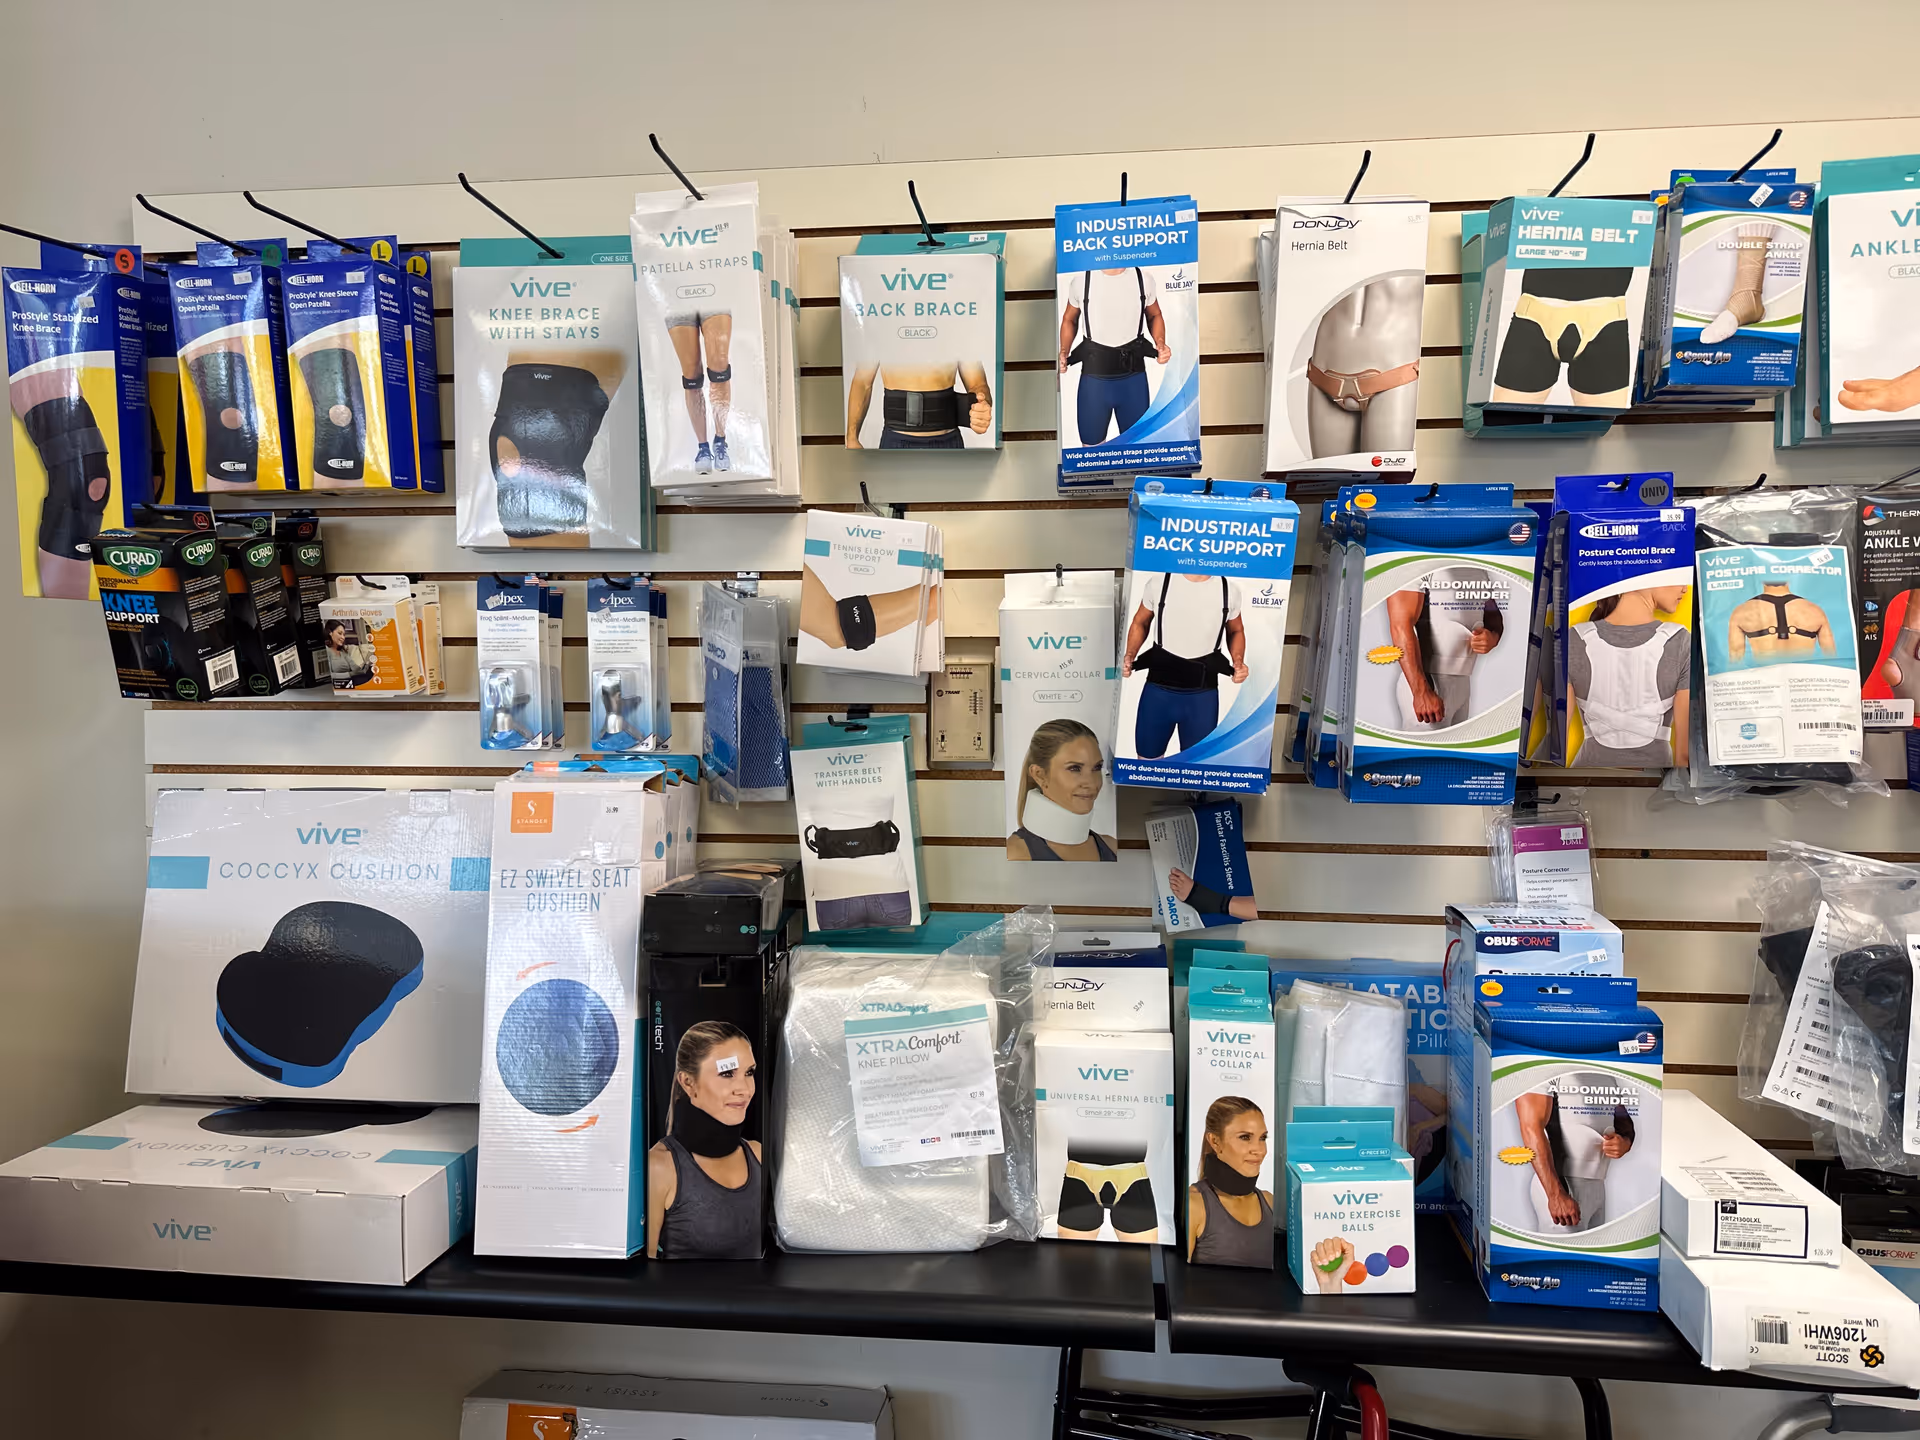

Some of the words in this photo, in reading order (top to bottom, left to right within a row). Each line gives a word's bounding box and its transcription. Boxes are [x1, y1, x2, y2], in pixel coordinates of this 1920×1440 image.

[1521, 206, 1560, 221] vive
[1076, 214, 1174, 234] INDUSTRIAL
[1293, 220, 1360, 229] DONJOY
[660, 226, 718, 248] vive
[1518, 225, 1584, 241] HERNIA
[1591, 228, 1638, 243] BELT
[1063, 237, 1107, 252] BACK
[1112, 230, 1188, 248] SUPPORT
[1292, 241, 1325, 250] Hernia
[1328, 240, 1348, 250] Belt
[1718, 241, 1763, 249] DOUBLE
[1766, 242, 1803, 250] STRAP
[378, 244, 386, 258] L
[1113, 252, 1157, 260] Suspenders
[120, 254, 129, 269] S
[641, 262, 693, 275] PATELLA
[700, 256, 748, 270] STRAPS
[880, 268, 947, 291] vive
[1183, 280, 1193, 288] JAY
[510, 277, 571, 297] vive
[684, 288, 707, 296] BLACK
[178, 295, 204, 303] ProStyle
[289, 292, 316, 300] ProStyle
[308, 300, 331, 308] Patella
[855, 303, 906, 316] BACK
[914, 302, 977, 316] BRACE
[489, 308, 532, 320] KNEE
[541, 308, 600, 320] BRACE
[13, 324, 34, 332] Knee
[36, 324, 61, 334] Brace
[490, 327, 535, 339] WITH
[543, 326, 600, 339] STAYS
[905, 329, 931, 337] BLACK
[1642, 486, 1666, 498] UNIV
[846, 525, 882, 539] vive
[1161, 517, 1271, 538] INDUSTRIAL
[1662, 523, 1686, 531] BACK
[1144, 536, 1195, 552] BACK
[1199, 539, 1285, 557] SUPPORT
[1864, 537, 1909, 549] ANKLE
[186, 543, 213, 560] CURAD
[833, 543, 862, 553] TENNIS
[865, 547, 894, 557] ELBOW
[1579, 548, 1614, 557] Posture
[1615, 547, 1649, 555] Control
[1651, 546, 1675, 554] Brace
[110, 550, 155, 566] CURAD
[843, 552, 881, 563] SUPPORT
[1178, 558, 1196, 566] with
[1198, 559, 1248, 569] Suspenders
[1705, 556, 1741, 567] vive
[1706, 566, 1766, 579] POSTURE
[1770, 565, 1842, 576] CORRECTOR
[1420, 580, 1510, 590] ABDOMINAL
[1252, 597, 1269, 605] BLUE
[1270, 598, 1284, 606] JAY
[1456, 591, 1509, 600] BINDER
[102, 592, 158, 614] KNEE
[106, 611, 159, 624] SUPPORT
[1027, 632, 1082, 650] vive
[1015, 671, 1061, 679] CERVICAL
[1064, 670, 1101, 678] COLLAR
[827, 753, 864, 765] vive
[814, 769, 859, 779] TRANSFER
[862, 767, 882, 775] BELT
[1138, 765, 1180, 774] duo-tension
[1204, 770, 1231, 778] provide
[816, 779, 839, 788] WITH
[842, 776, 882, 786] HANDLES
[1129, 774, 1165, 782] abdominal
[1221, 780, 1251, 788] support.
[1214, 812, 1224, 838] Plantar
[296, 822, 362, 845] vive
[1220, 838, 1230, 866] Fasciitis
[220, 862, 319, 880] COCCYX
[331, 863, 440, 880] CUSHION
[500, 870, 517, 888] EZ
[526, 869, 584, 888] SWIVEL
[593, 868, 630, 888] SEAT
[1224, 867, 1234, 890] Sleeve
[527, 893, 600, 912] CUSHION
[1166, 896, 1179, 926] DARCO
[1484, 936, 1552, 946] OBUSFORME
[1077, 1001, 1095, 1010] Belt
[1207, 1029, 1251, 1044] vive
[1212, 1049, 1264, 1059] CERVICAL
[1623, 1045, 1638, 1054] 36.99
[858, 1058, 887, 1069] KNEE
[890, 1053, 930, 1067] PILLOW
[1210, 1060, 1252, 1069] COLLAR
[1078, 1064, 1129, 1081] vive
[1548, 1085, 1639, 1095] ABDOMINAL
[1050, 1092, 1101, 1102] UNIVERSAL
[1105, 1095, 1139, 1103] HERNIA
[1144, 1096, 1164, 1104] BELT
[1584, 1096, 1639, 1106] BINDER
[1333, 1190, 1378, 1205] vive
[1314, 1211, 1345, 1220] HAND
[1350, 1209, 1401, 1219] EXERCISE
[152, 1218, 212, 1241] vive
[1342, 1223, 1374, 1232] BALLS
[1857, 1248, 1915, 1259] OBUSFORME
[1866, 1318, 1879, 1327] UN
[1804, 1324, 1867, 1342] 1206WHI
[1816, 1352, 1849, 1364] SCOTT
